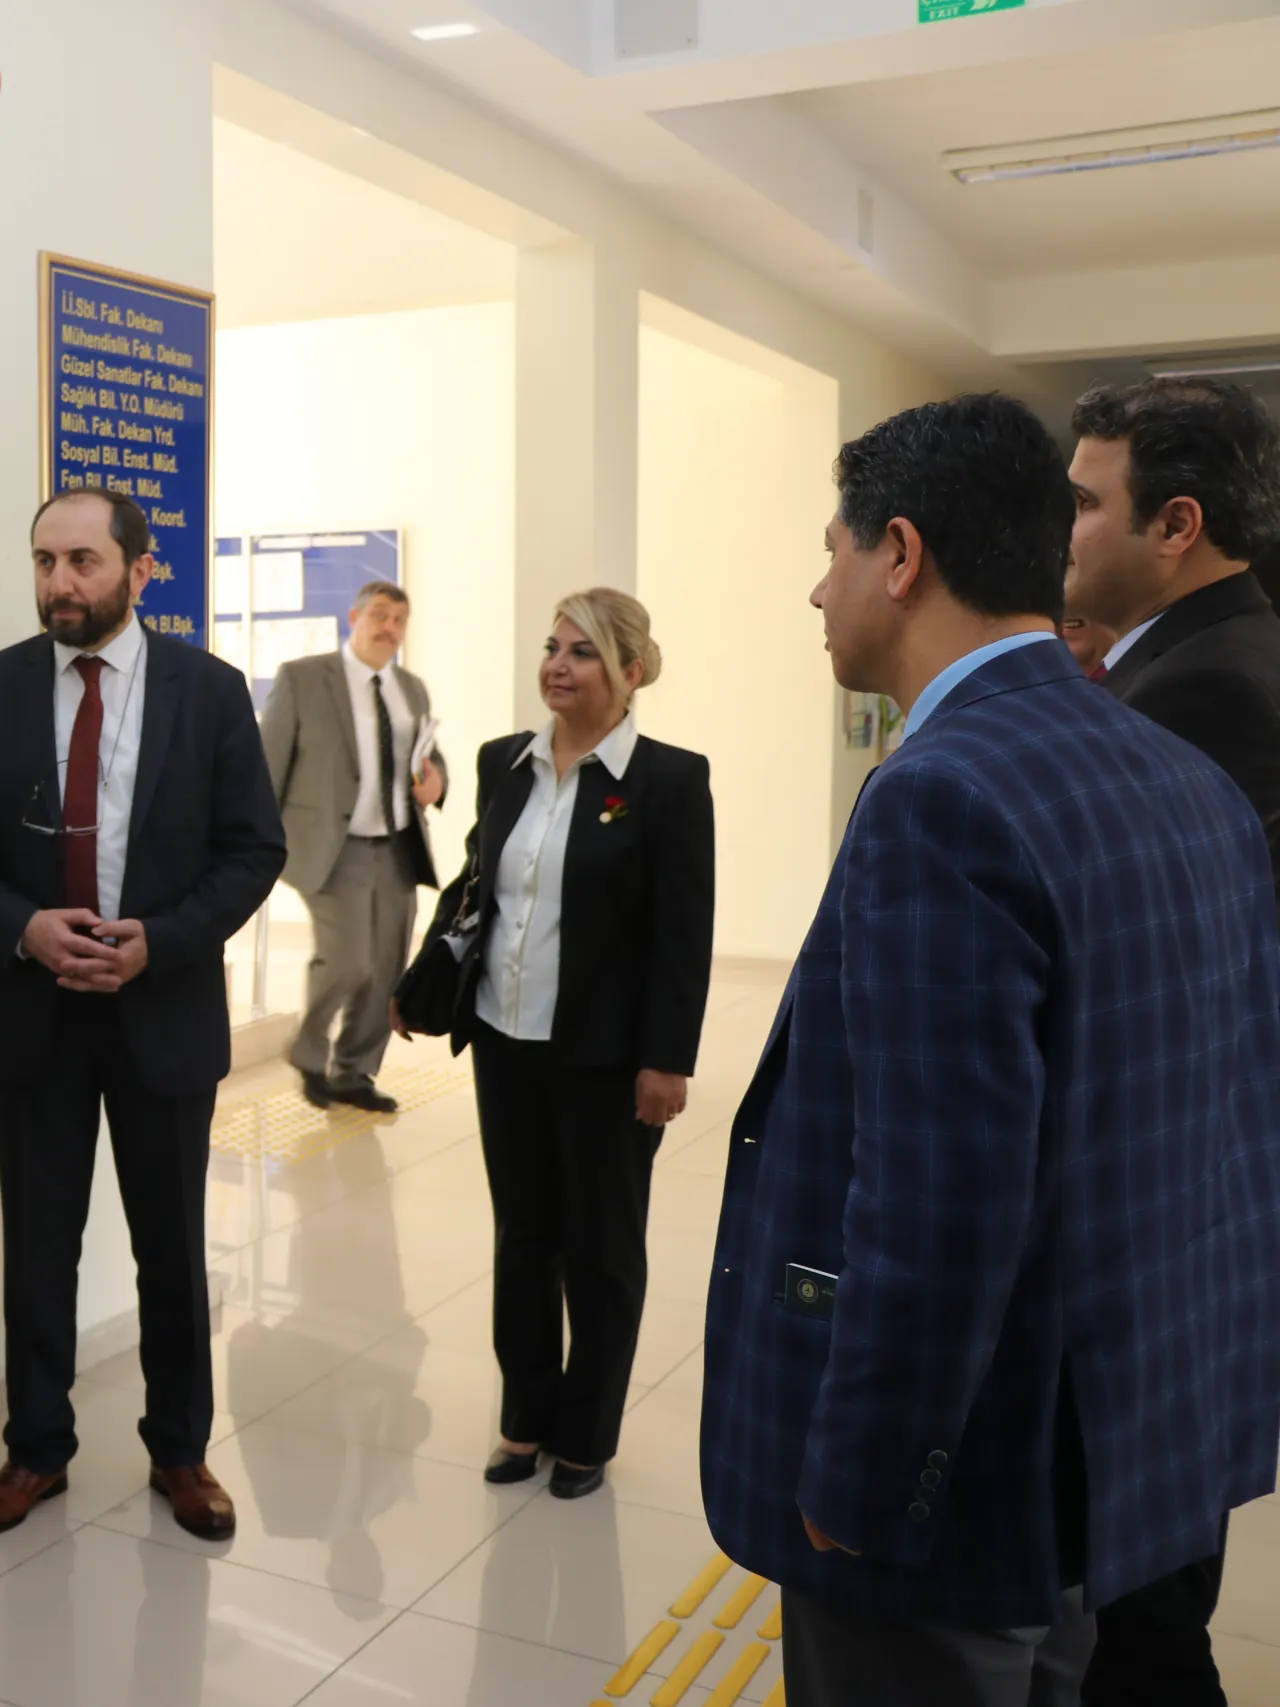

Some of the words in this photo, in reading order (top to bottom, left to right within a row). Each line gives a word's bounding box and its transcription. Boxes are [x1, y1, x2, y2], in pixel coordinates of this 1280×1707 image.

[930, 7, 959, 20] EXIT
[100, 302, 124, 325] Fak.
[127, 308, 164, 334] Dekanı
[62, 324, 130, 355] Mühendislik
[132, 338, 155, 361] Fak.
[157, 344, 193, 368] Dekanı
[61, 354, 94, 378] Güzel
[97, 360, 142, 386] Sanatlar
[144, 369, 166, 391] Fak.
[168, 374, 204, 397] Dekanı
[61, 383, 97, 409] Sağlık
[99, 389, 117, 410] Bil.
[120, 392, 141, 414] Y.O.
[144, 396, 184, 421] Müdürü
[61, 412, 90, 434] Müh.
[92, 416, 116, 438] Fak.
[118, 421, 152, 442] Dekan
[154, 426, 175, 446] Yrd.
[61, 440, 100, 467] Sosyal
[102, 446, 121, 467] Bil.
[123, 448, 151, 470] Enst.
[153, 452, 179, 473] Müd.
[61, 469, 83, 488] Fen
[86, 472, 102, 488] Bil
[107, 474, 135, 496] Enst.
[137, 478, 163, 499] Müd.
[152, 507, 186, 528] Koord.
